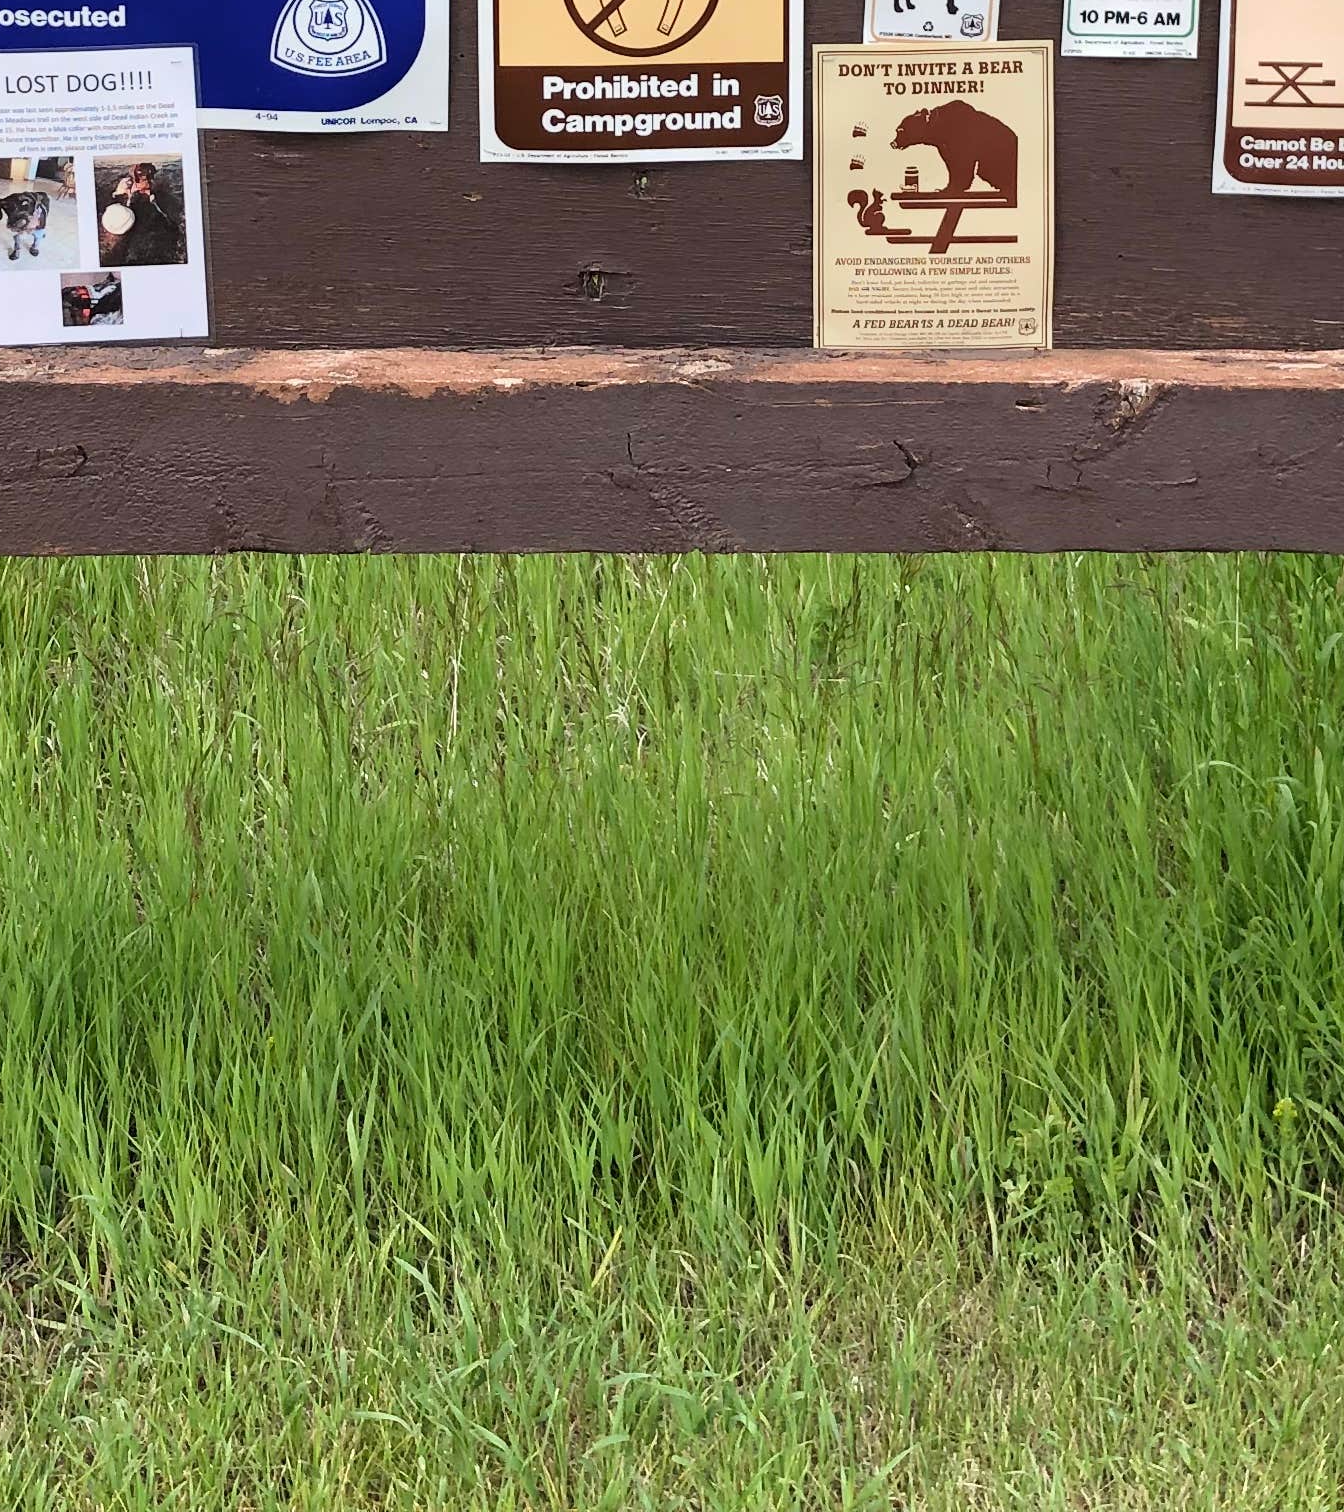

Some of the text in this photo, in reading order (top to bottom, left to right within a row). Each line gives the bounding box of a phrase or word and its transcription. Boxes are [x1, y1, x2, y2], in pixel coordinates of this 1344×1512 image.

[1079, 9, 1099, 24] 10
[1153, 11, 1181, 27] AM
[306, 54, 334, 68] FEE
[334, 49, 373, 68] AREA
[897, 62, 957, 77] INVITE
[961, 61, 974, 75] A
[978, 60, 1024, 75] BEAR
[5, 71, 151, 94] LOST DOG!!!!
[544, 74, 739, 99] Prohibited in
[883, 80, 985, 96] TO DINNER!
[542, 106, 740, 136] Campground
[1240, 135, 1307, 152] Cannot
[1309, 137, 1335, 153] Be
[1239, 152, 1284, 169] Over
[1285, 155, 1310, 170] 24
[852, 319, 861, 329] A
[863, 319, 886, 329] FED
[888, 319, 920, 329] BEAR
[935, 319, 945, 329] A
[947, 318, 979, 329] DEAD
[980, 317, 1016, 329] BEAR!
